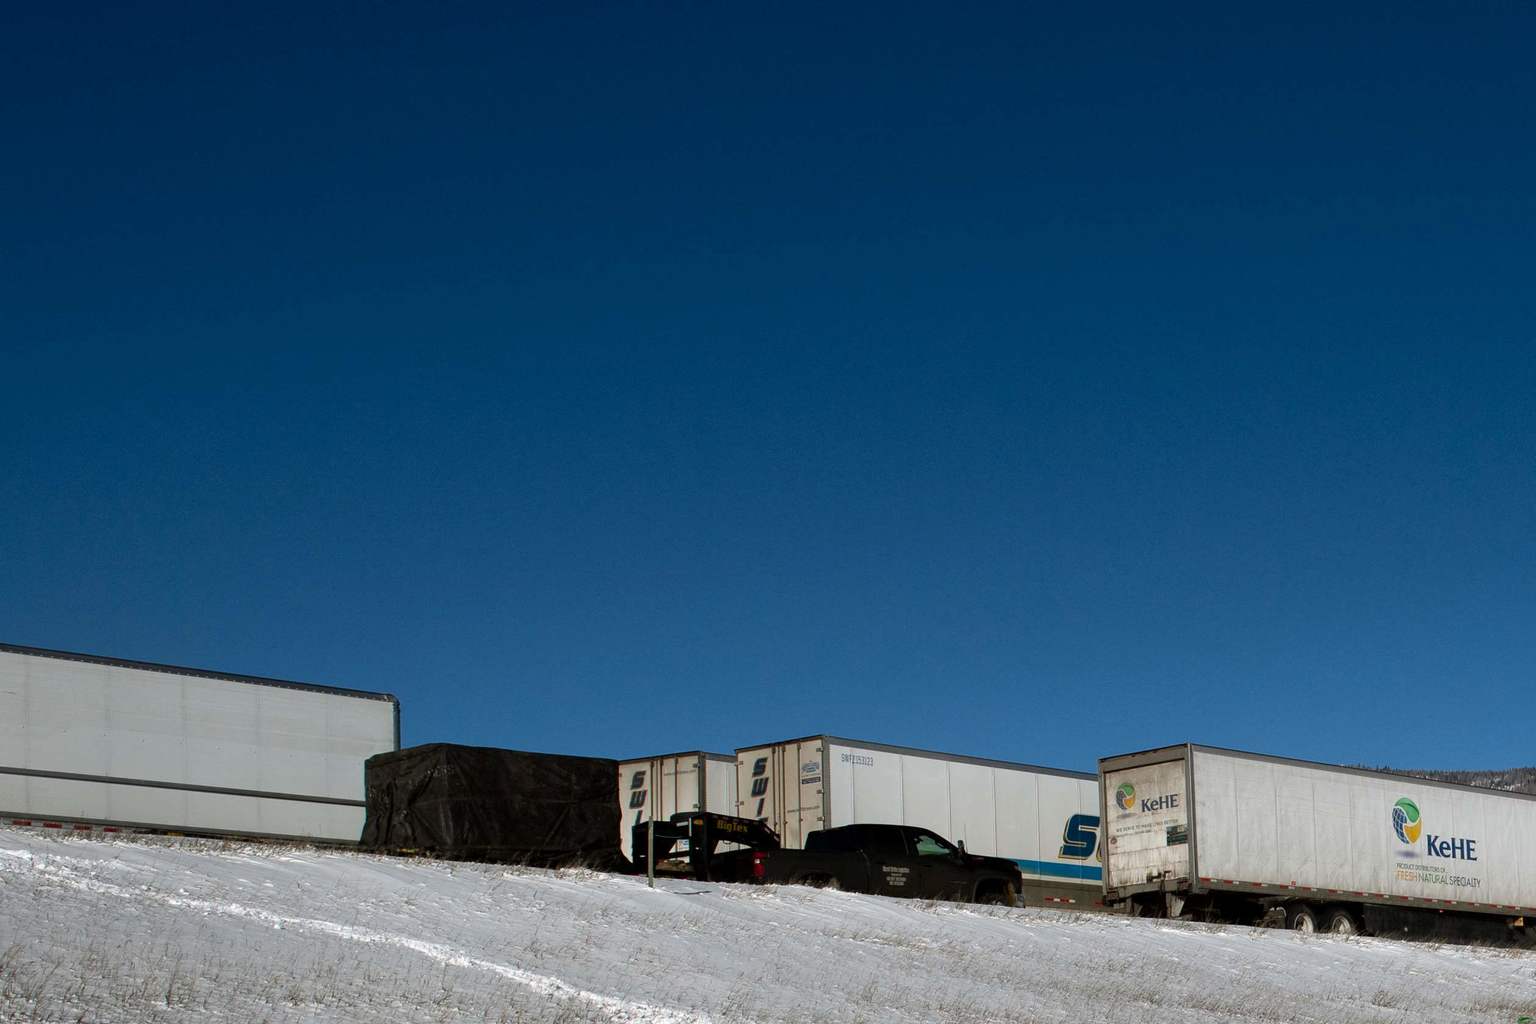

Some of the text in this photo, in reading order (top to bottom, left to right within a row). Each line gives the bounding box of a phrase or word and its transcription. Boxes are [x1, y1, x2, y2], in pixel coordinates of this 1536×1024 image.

[1141, 794, 1179, 812] KeHE
[1426, 834, 1478, 861] KeHE
[1397, 870, 1481, 887] FRESH NATURAL SPECIALTY
